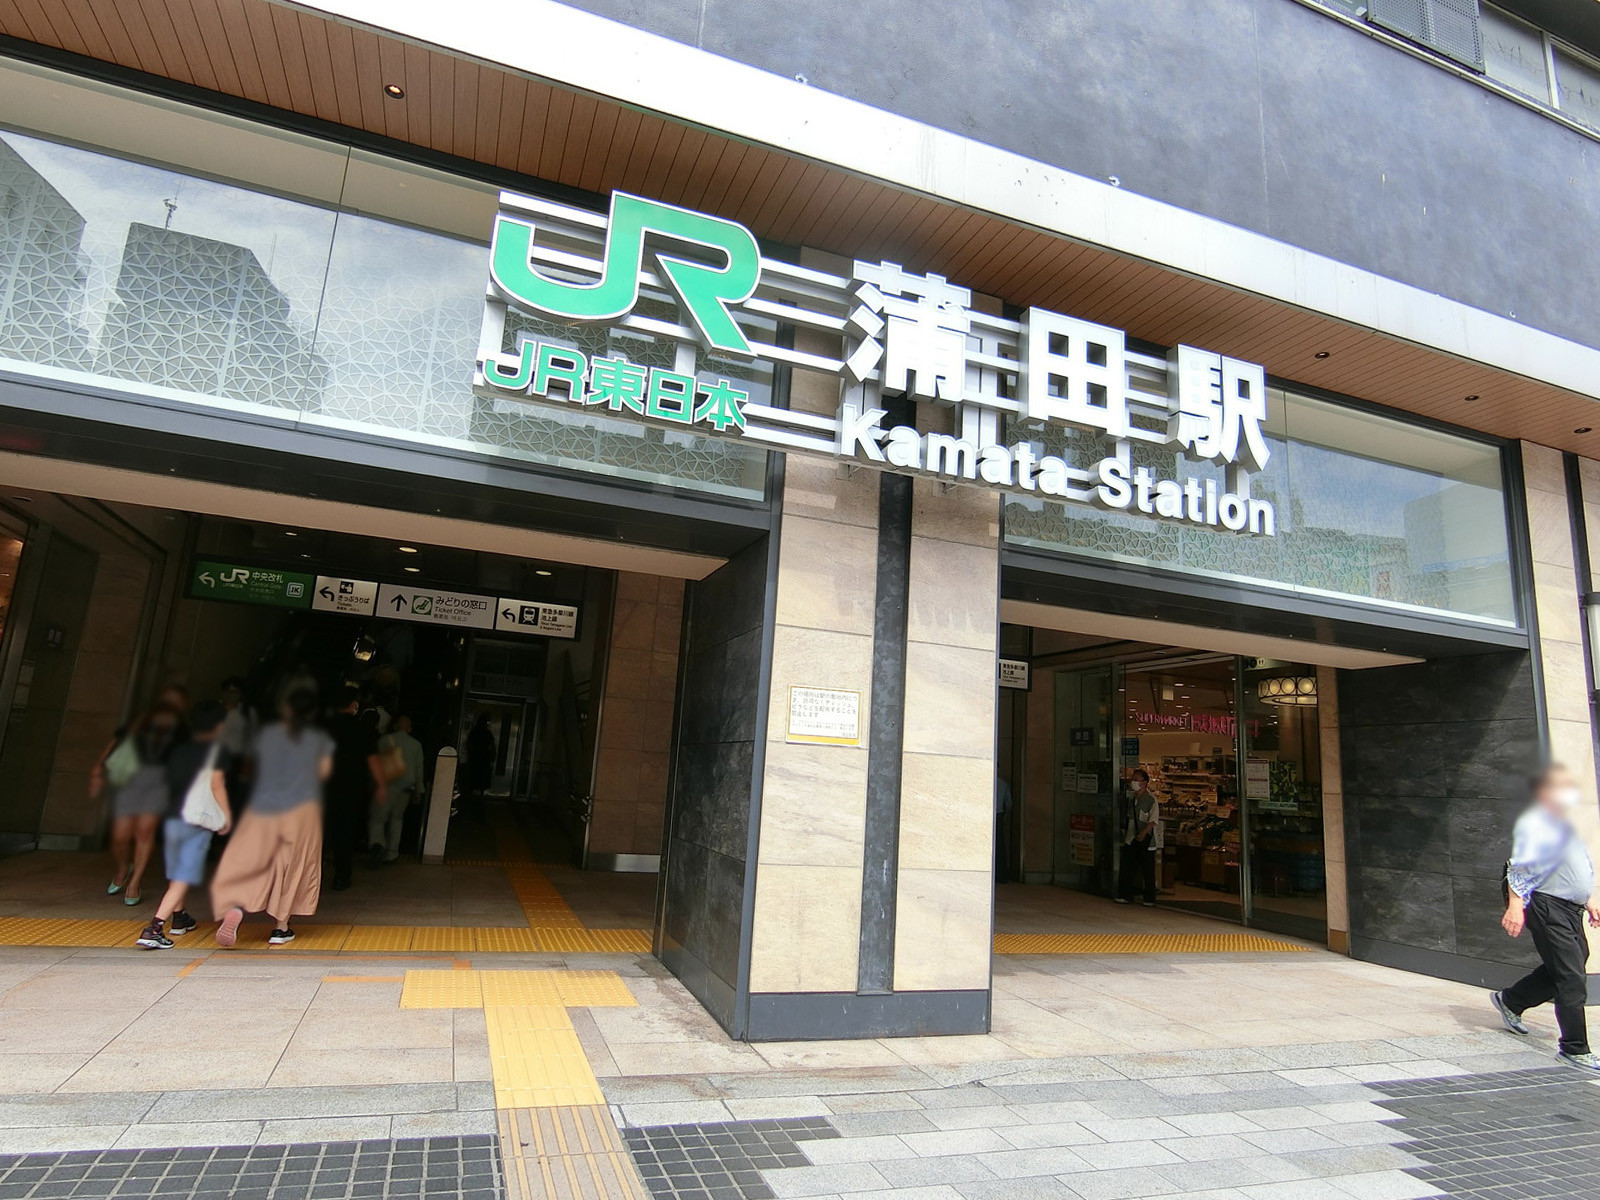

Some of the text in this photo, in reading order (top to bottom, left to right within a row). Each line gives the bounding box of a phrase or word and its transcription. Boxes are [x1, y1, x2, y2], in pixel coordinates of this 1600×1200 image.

[489, 189, 762, 352] JR
[843, 259, 1271, 472] 蒲田駅
[482, 338, 749, 433] JR東日本
[840, 403, 1276, 537] Kamata Station
[220, 569, 250, 584] JR
[252, 571, 284, 584] 中央改札
[290, 586, 300, 595] JK
[337, 595, 370, 604] きっぷうりば
[435, 595, 488, 610] みどりの窓口
[434, 606, 472, 616] Ticket Office
